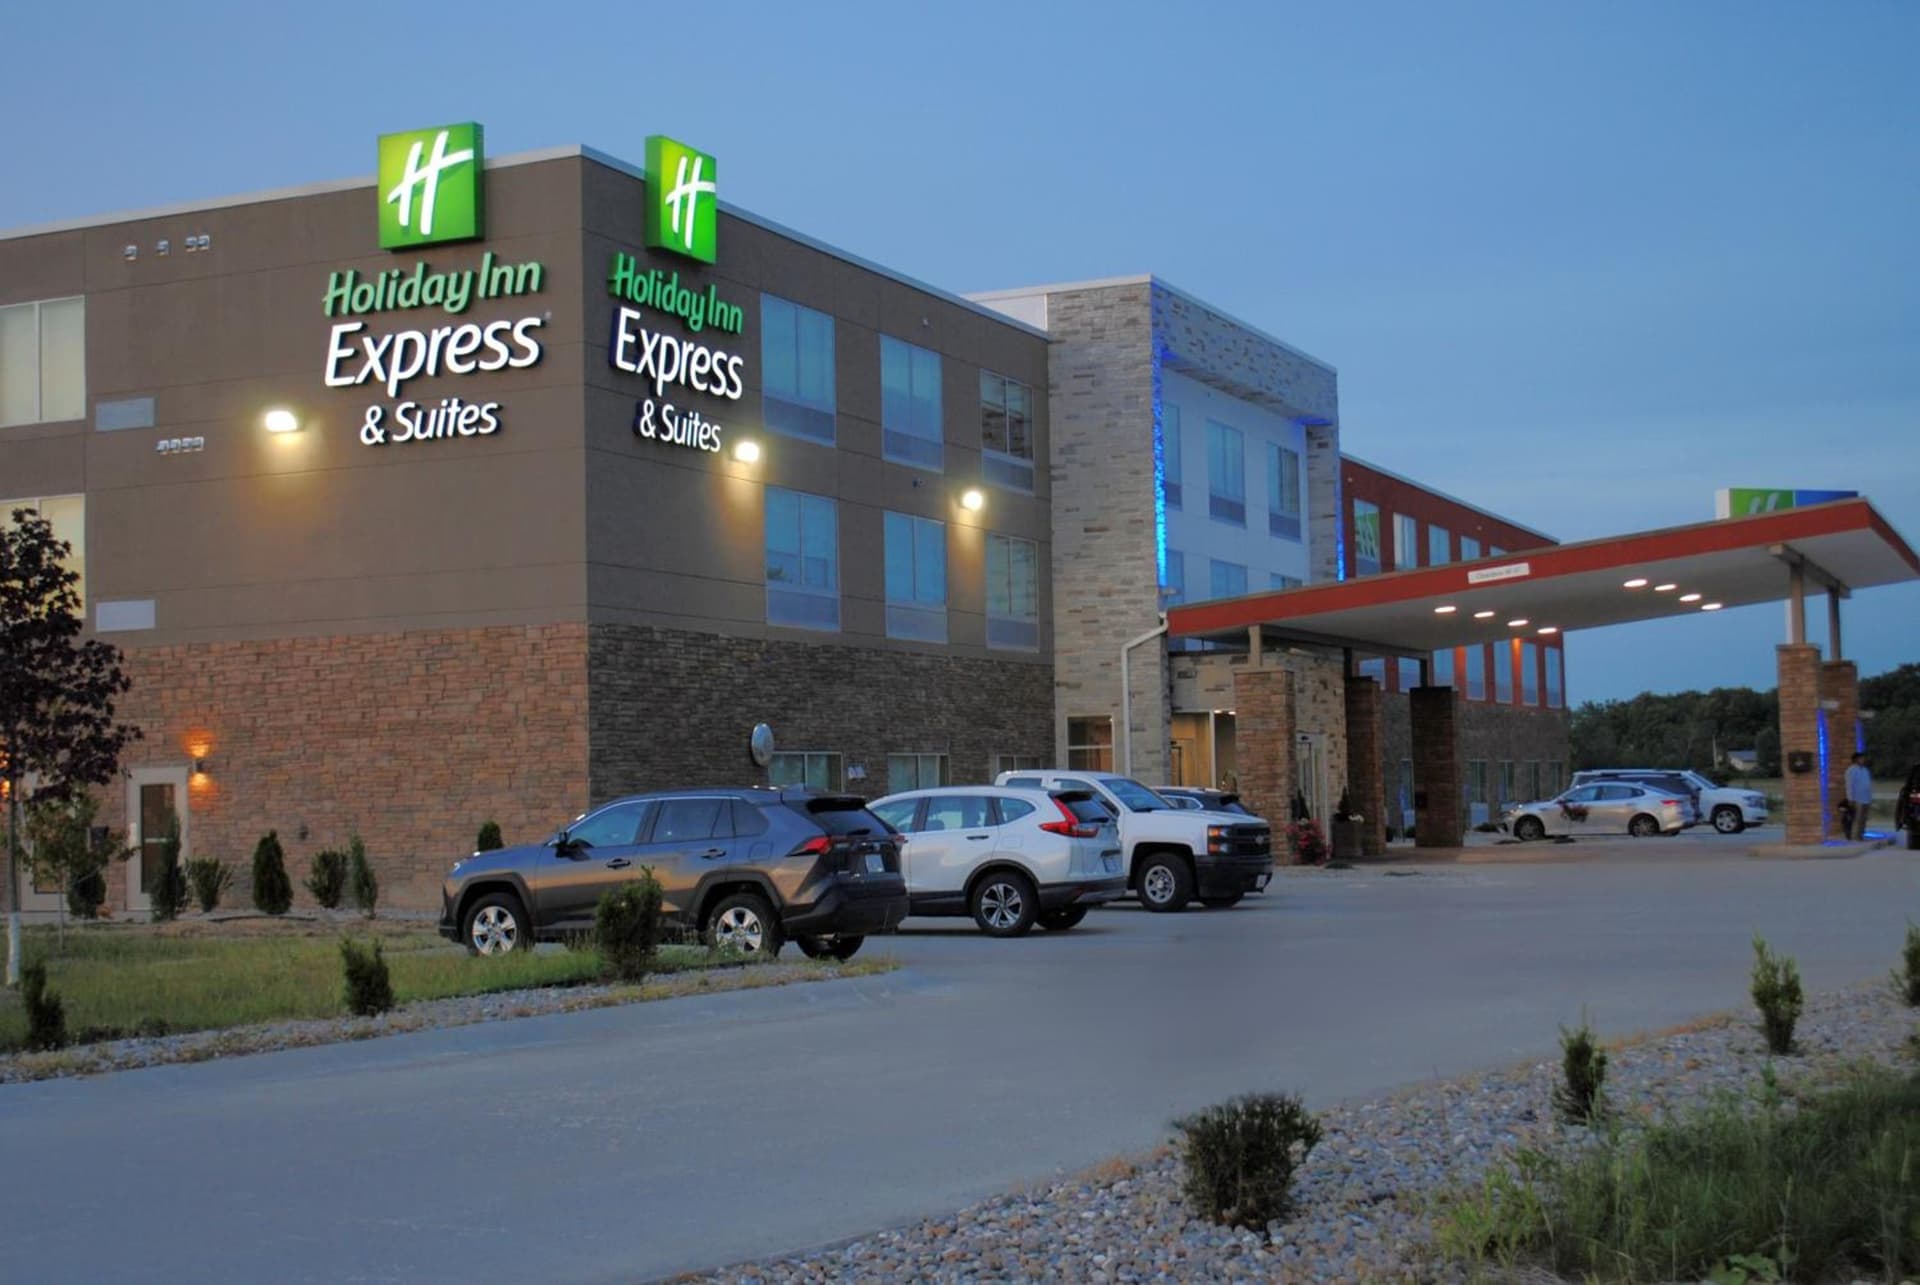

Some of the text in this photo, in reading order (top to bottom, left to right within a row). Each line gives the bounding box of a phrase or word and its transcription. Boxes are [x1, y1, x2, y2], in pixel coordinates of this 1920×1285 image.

[321, 251, 544, 317] Holiday Inn
[611, 252, 744, 335] Holiday Inn
[324, 316, 542, 398] Express
[614, 306, 744, 401] Express
[359, 397, 499, 446] & Suites
[639, 399, 722, 453] & Suites
